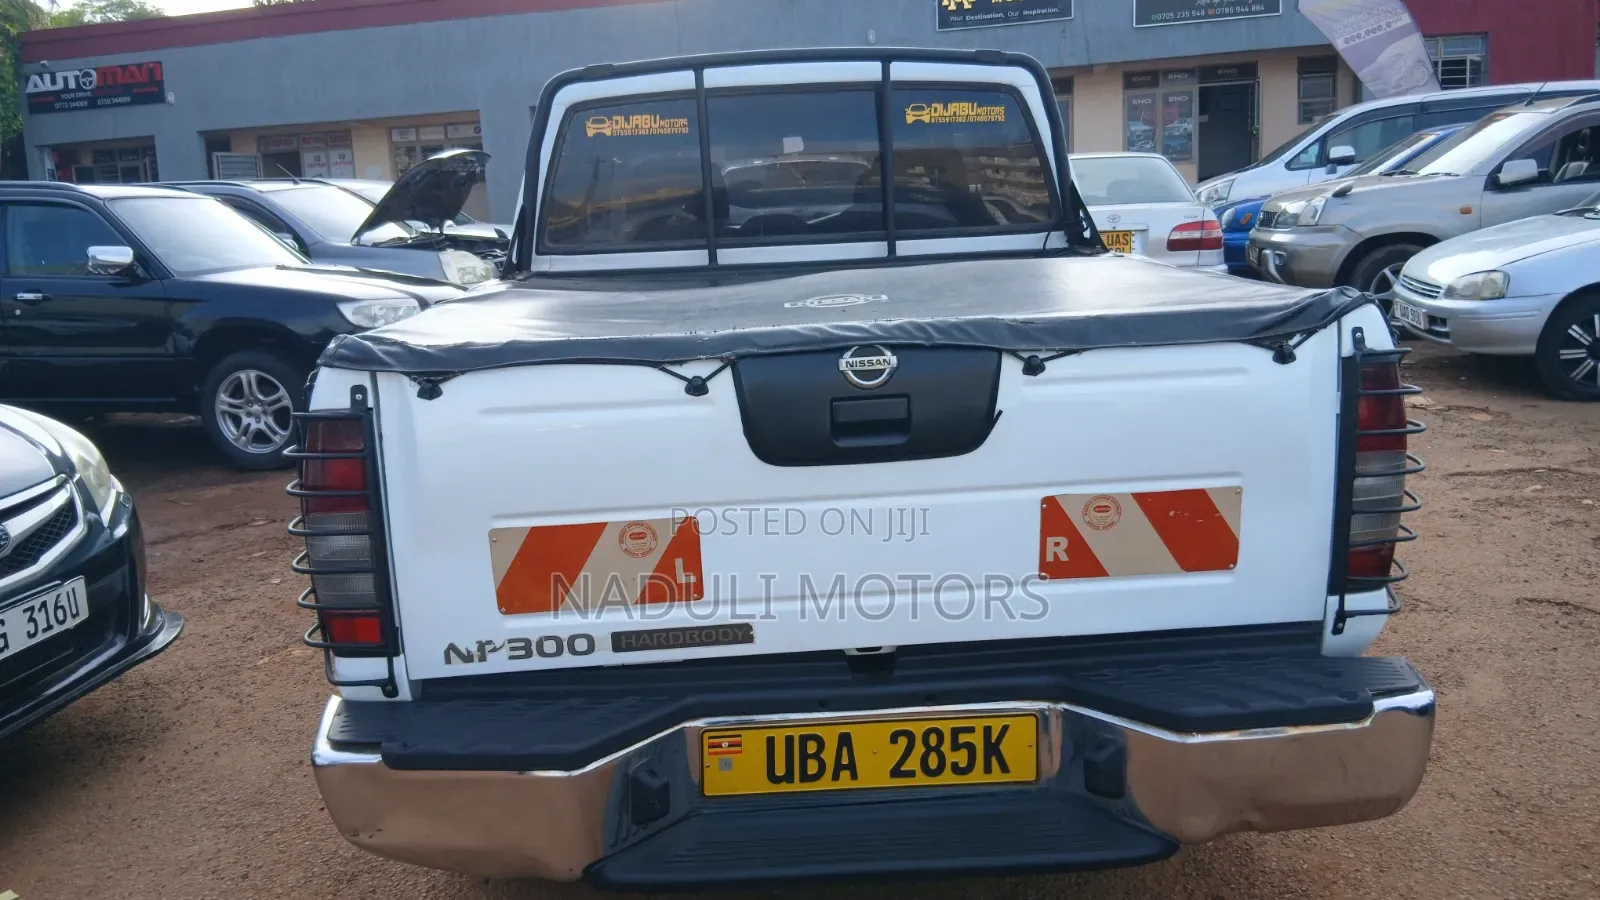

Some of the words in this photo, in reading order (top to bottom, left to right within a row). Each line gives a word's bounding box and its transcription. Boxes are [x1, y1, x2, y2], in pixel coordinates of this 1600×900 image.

[965, 12, 1005, 21] Destination,
[1022, 7, 1060, 16] Inspiration.
[1191, 9, 1205, 17] 948
[1235, 5, 1249, 13] 944
[60, 92, 75, 100] YOUR
[1132, 97, 1152, 105] ENO
[931, 102, 977, 116] DIJABU
[977, 106, 1005, 115] MOTORS
[612, 114, 660, 129] DIJABU
[660, 118, 688, 128] MOTORS
[1106, 232, 1129, 247] UAS
[845, 358, 891, 369] NISSAN
[1045, 535, 1069, 562] R
[674, 557, 697, 584] L
[22, 586, 80, 640] 316U
[621, 627, 747, 650] HARDBODY
[765, 731, 859, 785] UBA
[889, 723, 1011, 778] 285K
